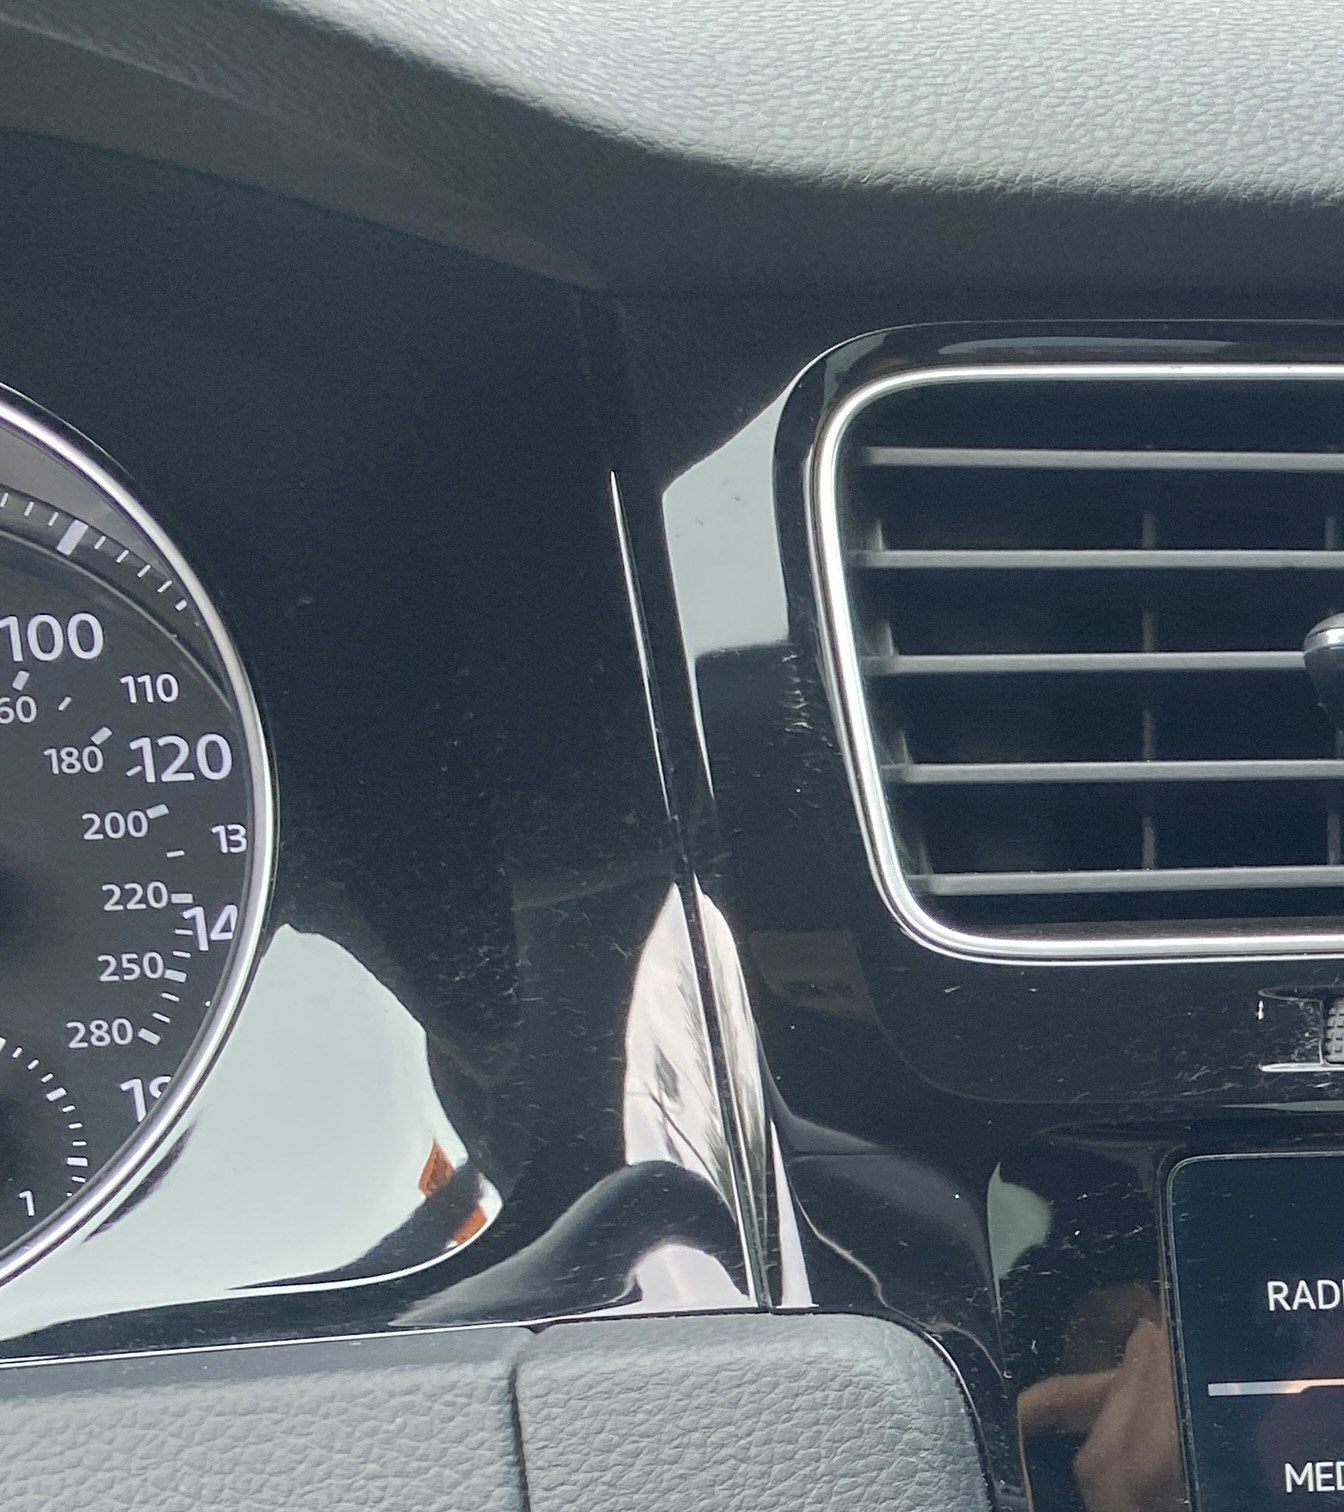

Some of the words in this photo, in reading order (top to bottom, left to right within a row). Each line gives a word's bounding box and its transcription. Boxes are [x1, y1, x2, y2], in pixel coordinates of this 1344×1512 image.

[0, 612, 104, 662] 100
[120, 672, 180, 703] 110
[43, 745, 104, 775] 180
[129, 733, 233, 783] 120
[82, 810, 149, 840] 200
[102, 881, 169, 912] 220
[98, 951, 165, 982] 250
[66, 1018, 134, 1049] 280
